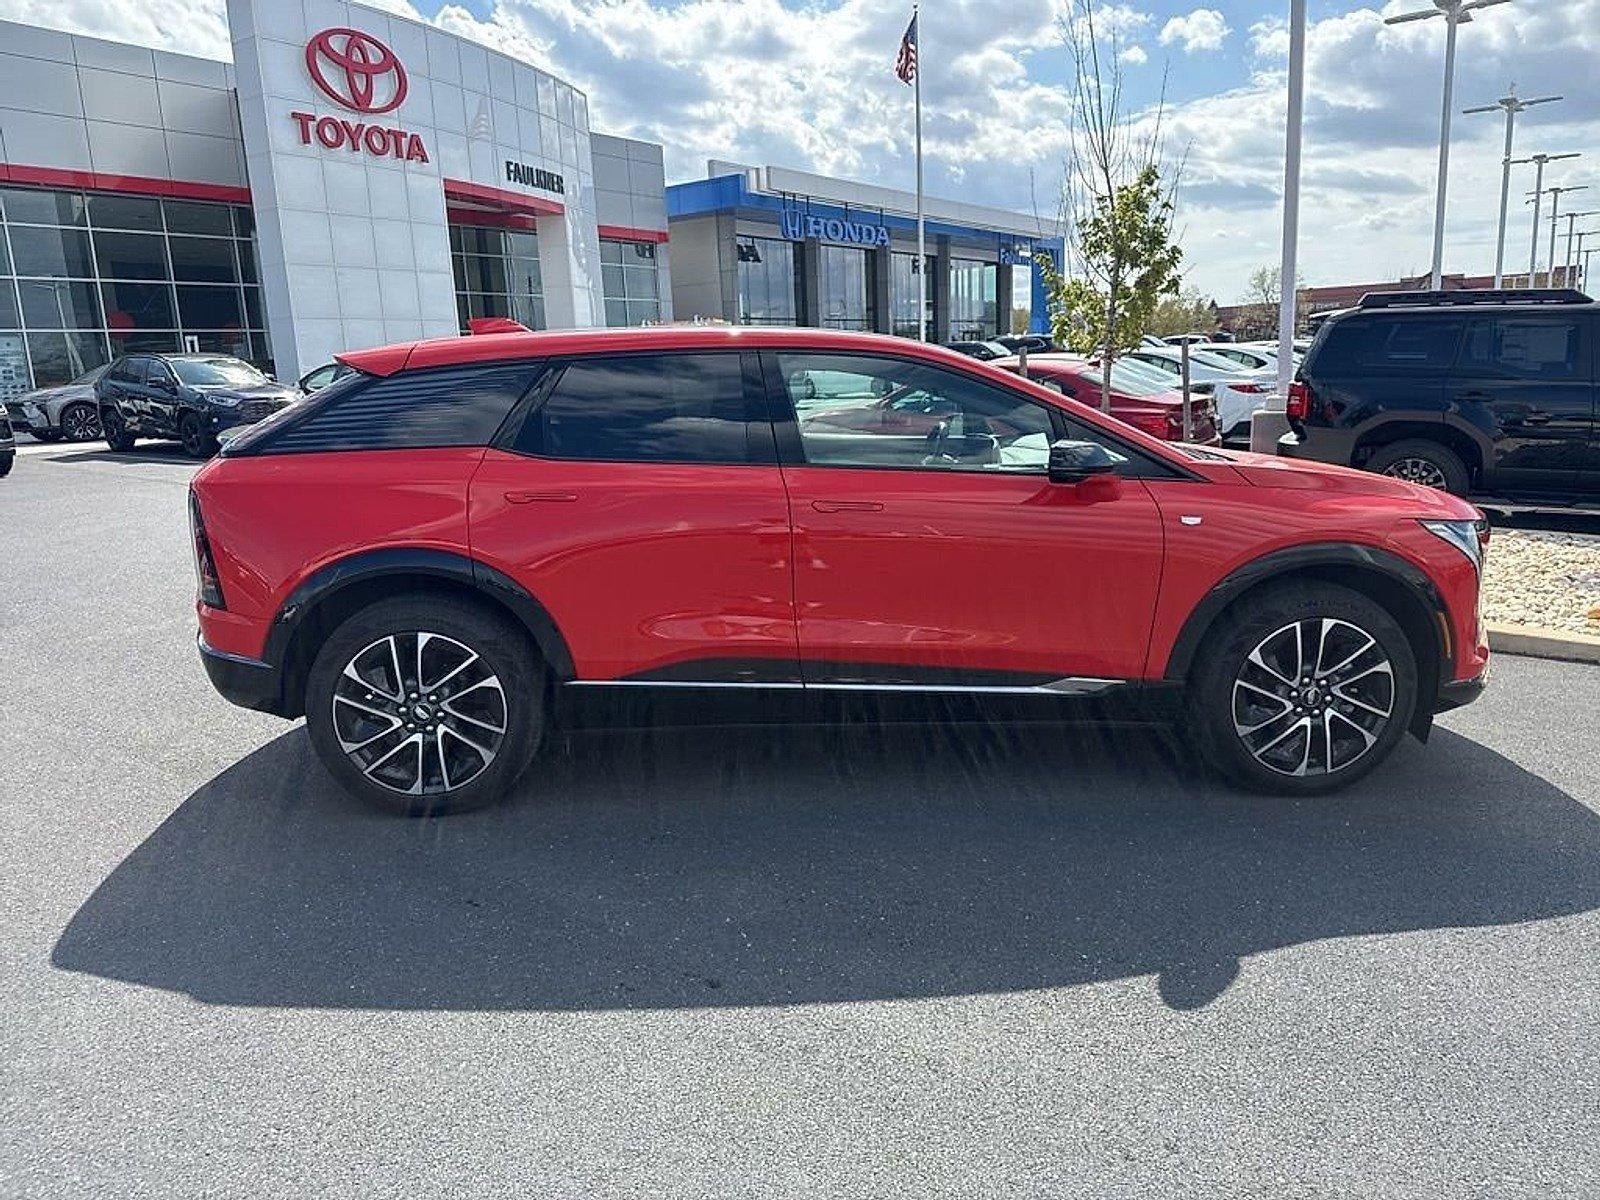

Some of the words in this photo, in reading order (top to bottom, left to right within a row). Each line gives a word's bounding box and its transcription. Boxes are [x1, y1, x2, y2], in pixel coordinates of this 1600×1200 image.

[291, 112, 429, 163] TOYOTA
[505, 160, 565, 195] FAULKNER
[805, 215, 889, 247] HONDA
